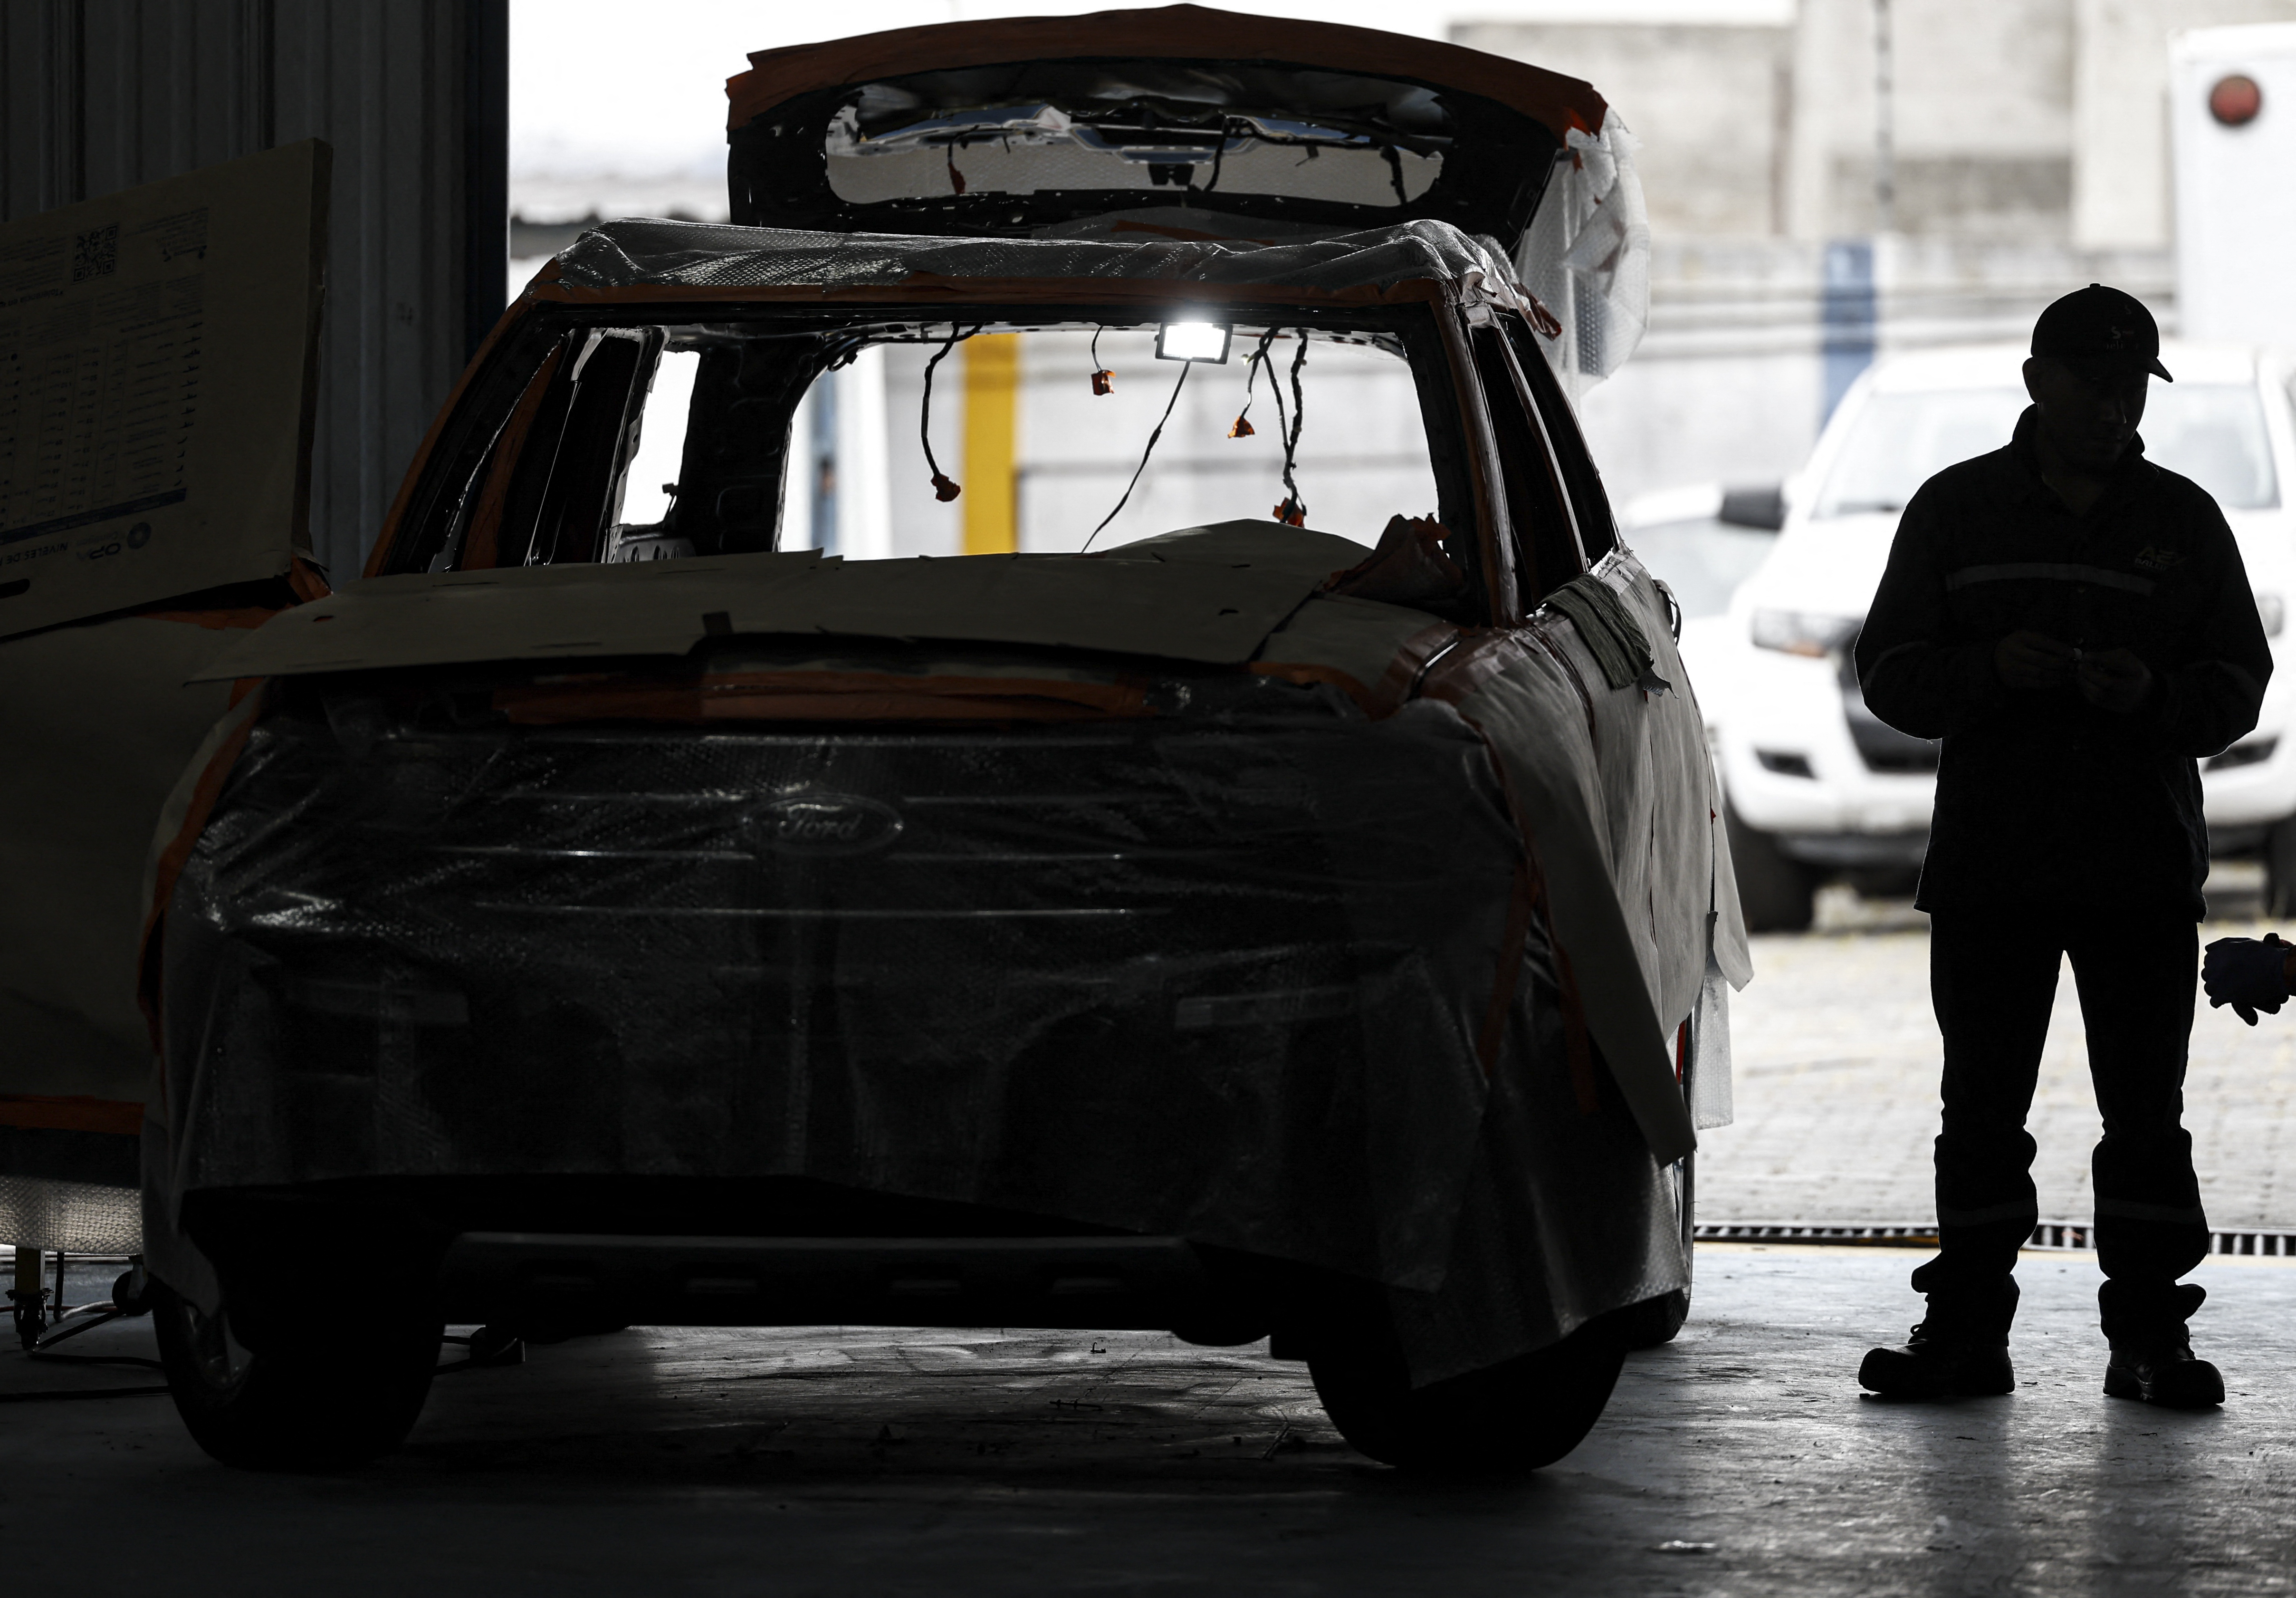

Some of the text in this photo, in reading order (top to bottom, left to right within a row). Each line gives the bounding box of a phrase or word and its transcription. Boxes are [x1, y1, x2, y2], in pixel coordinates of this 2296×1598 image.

[6, 553, 20, 564] DE
[24, 542, 67, 560] NIVELES
[778, 803, 863, 839] Ford
